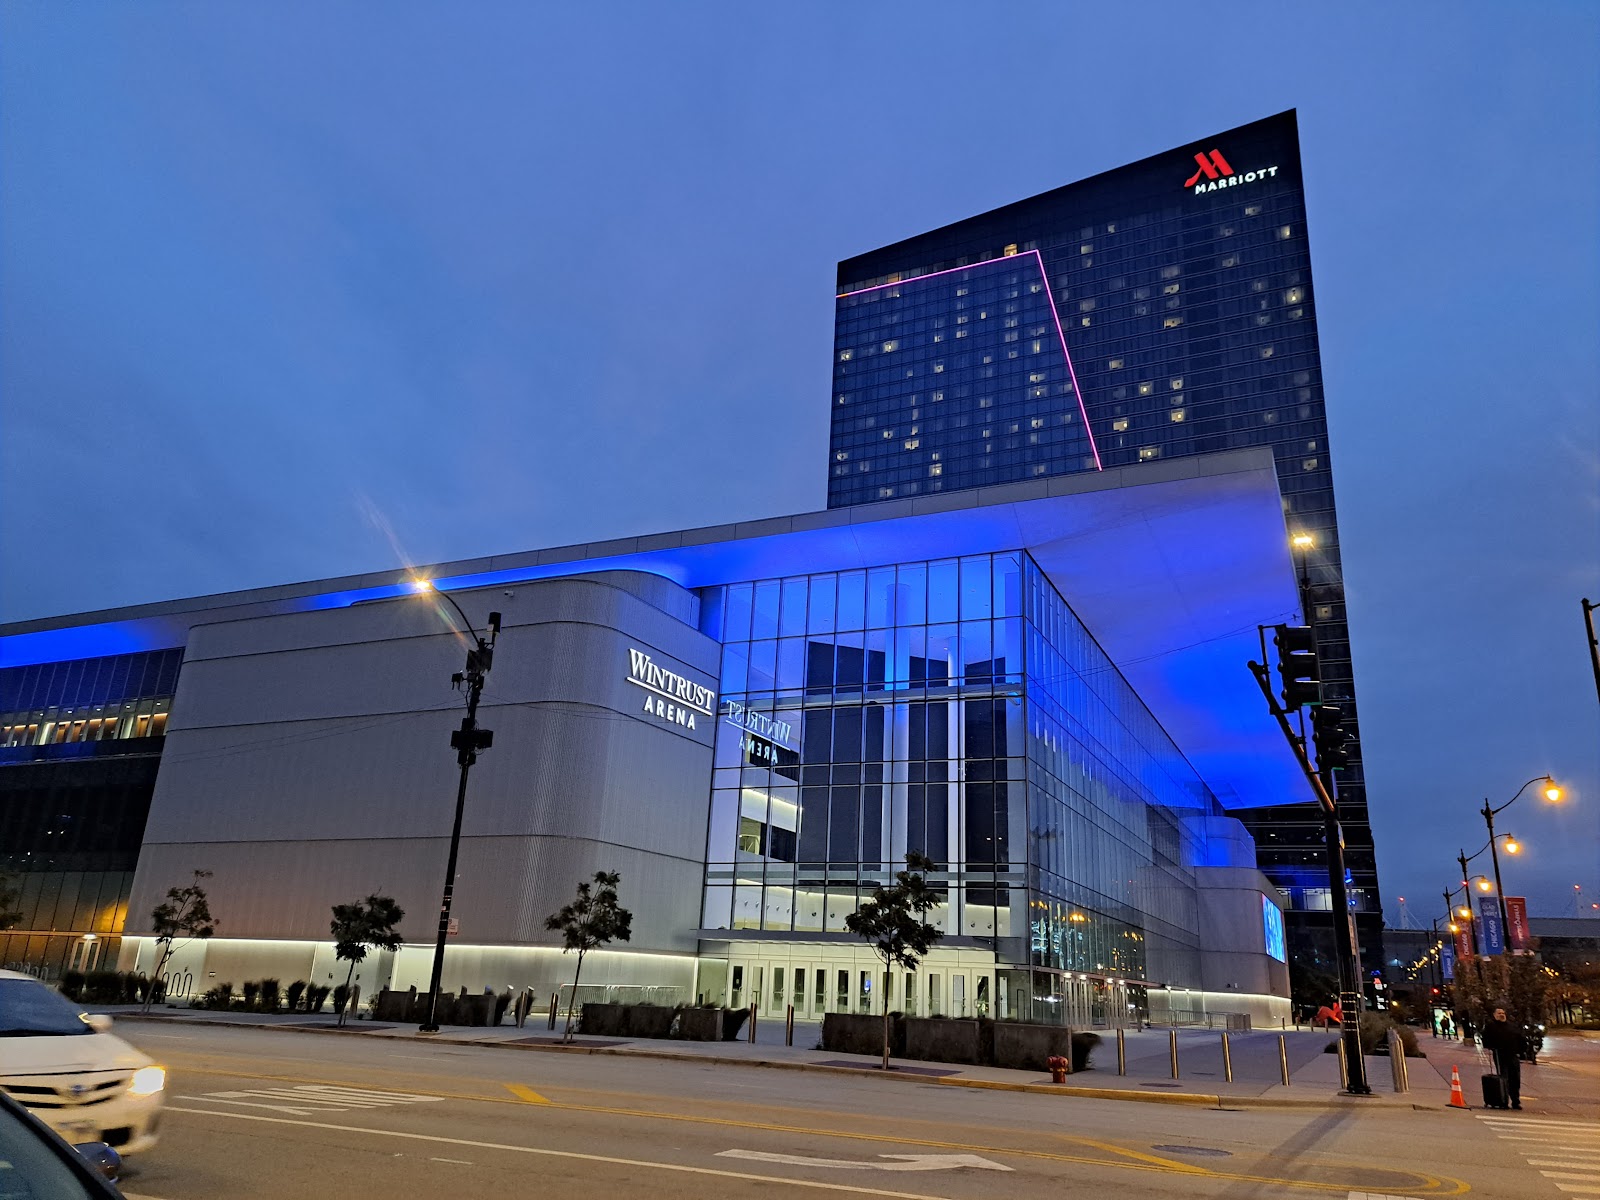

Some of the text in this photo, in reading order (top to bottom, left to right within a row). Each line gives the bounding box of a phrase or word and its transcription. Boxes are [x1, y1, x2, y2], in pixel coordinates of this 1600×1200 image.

[1195, 166, 1278, 194] MARRIOTT
[629, 648, 715, 711] WINTRUST
[643, 695, 696, 731] ARENA
[1489, 920, 1498, 948] CHICAGO
